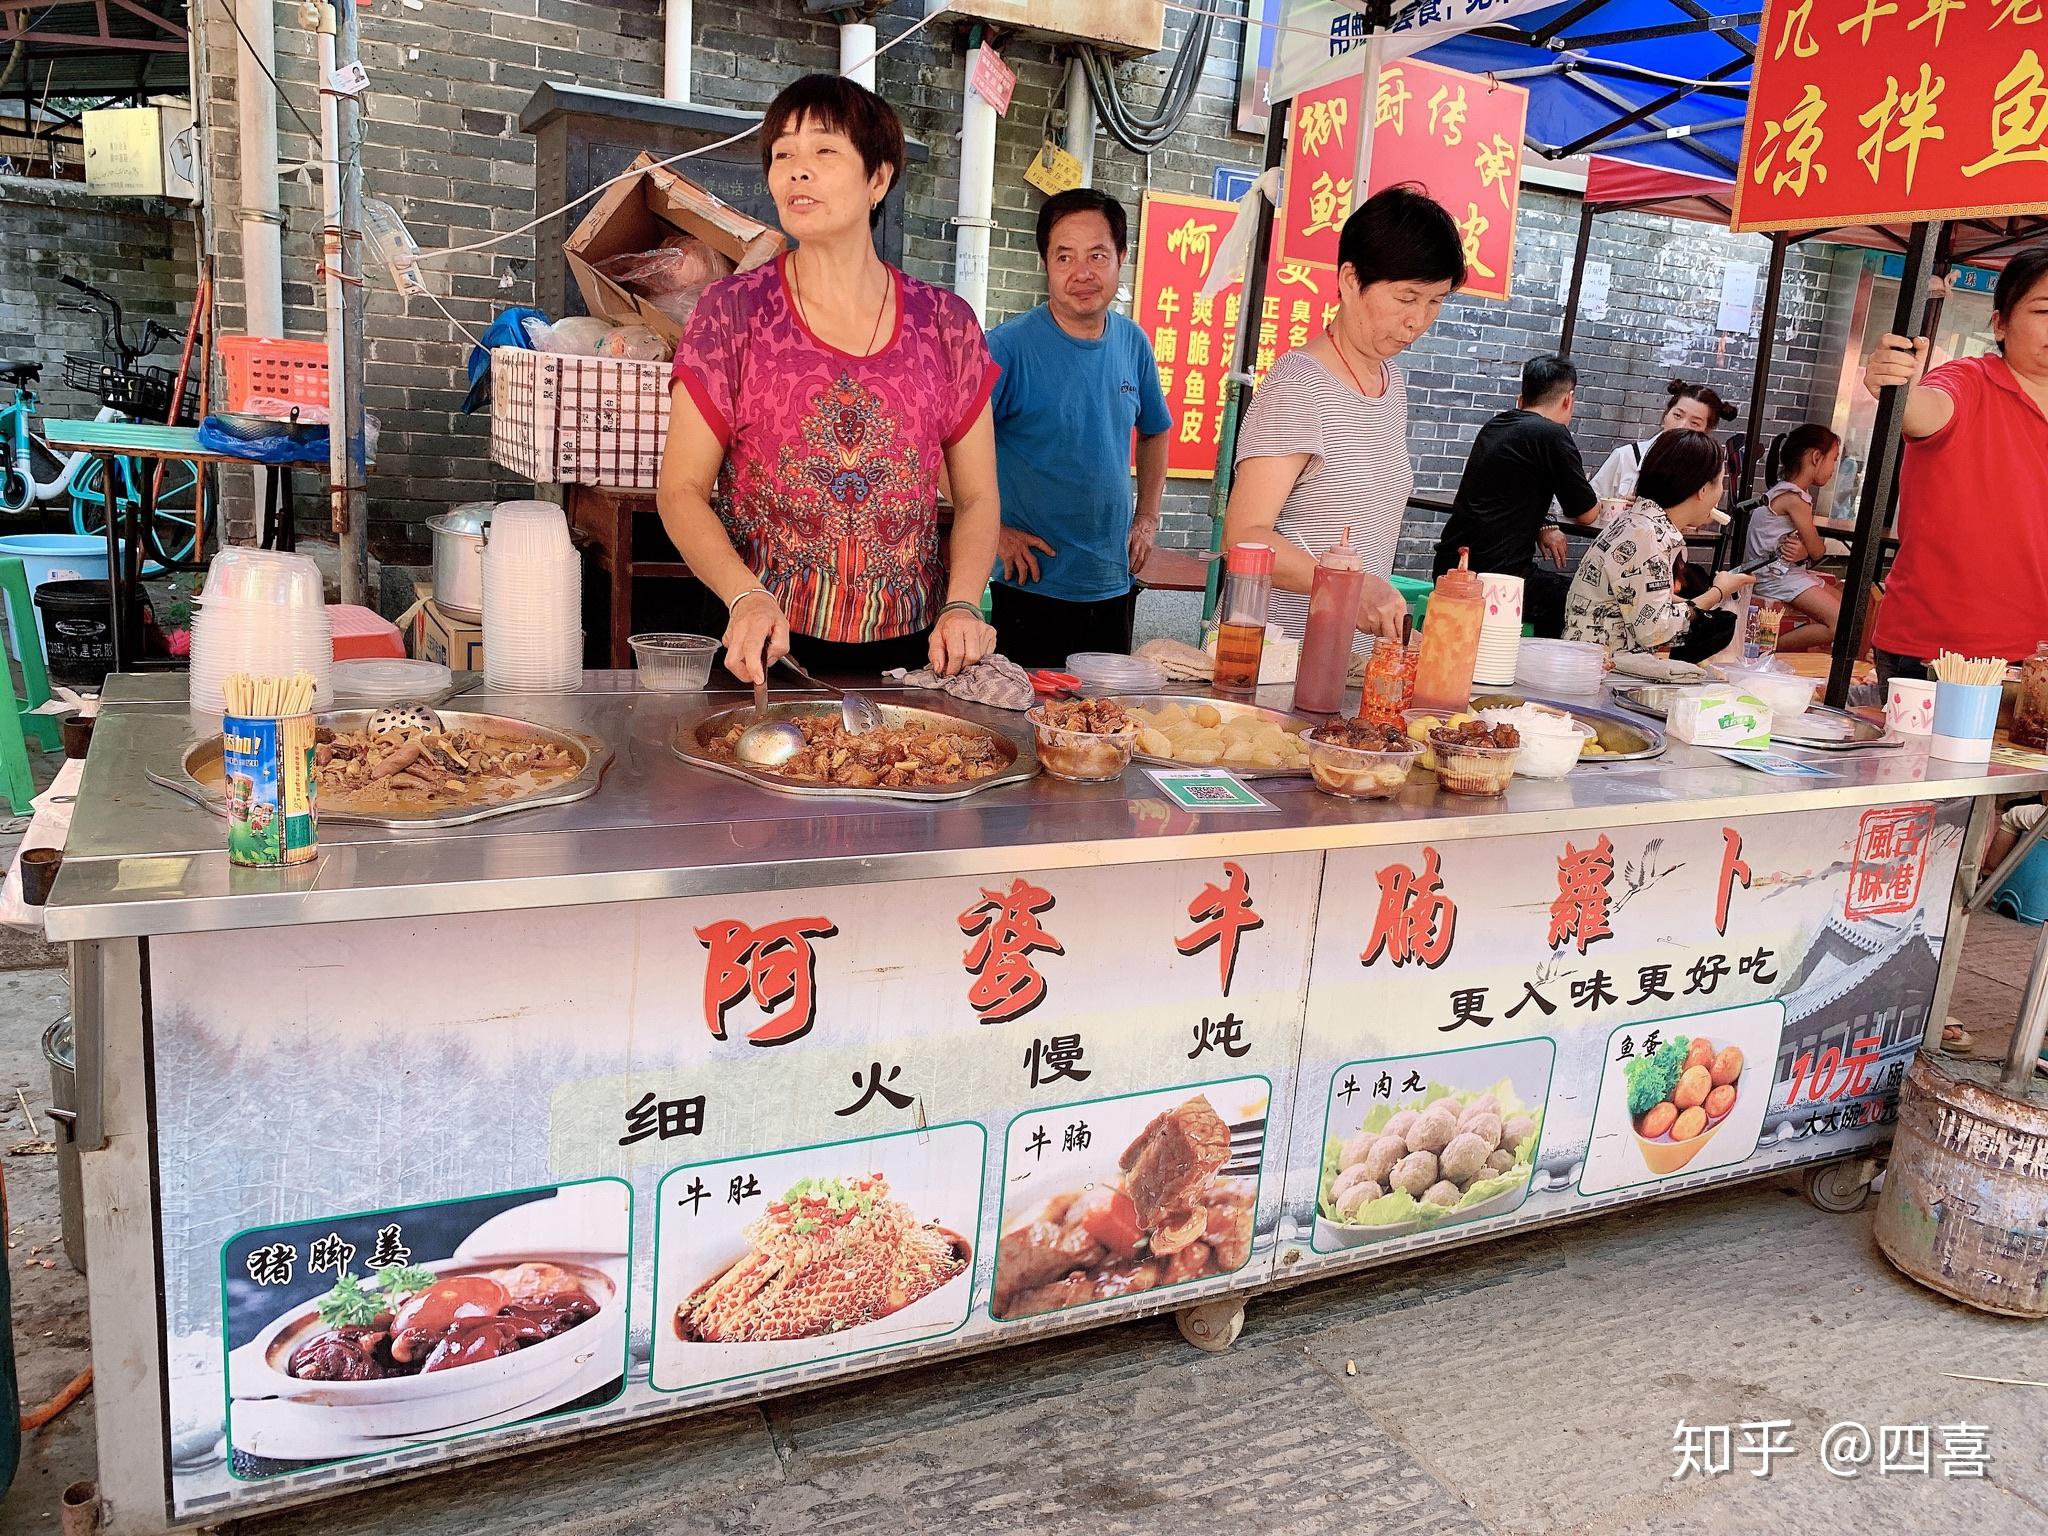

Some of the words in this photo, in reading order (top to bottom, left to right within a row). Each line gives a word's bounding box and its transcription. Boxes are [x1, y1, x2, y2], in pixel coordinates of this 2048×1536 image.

[1252, 296, 1280, 393] 正宗鲜
[1288, 300, 1310, 350] 臭名
[1179, 291, 1214, 443] 爽脆鱼皮
[1438, 946, 1778, 1032] 更入味更好吃
[1615, 1029, 1662, 1061] 鱼蛋
[619, 1013, 1252, 1146] 细火慢炖
[1336, 1069, 1426, 1101] 牛肉丸
[1024, 1119, 1092, 1162] 牛腩
[679, 1173, 761, 1216] 牛肚
[247, 1223, 411, 1286] 猪脚姜
